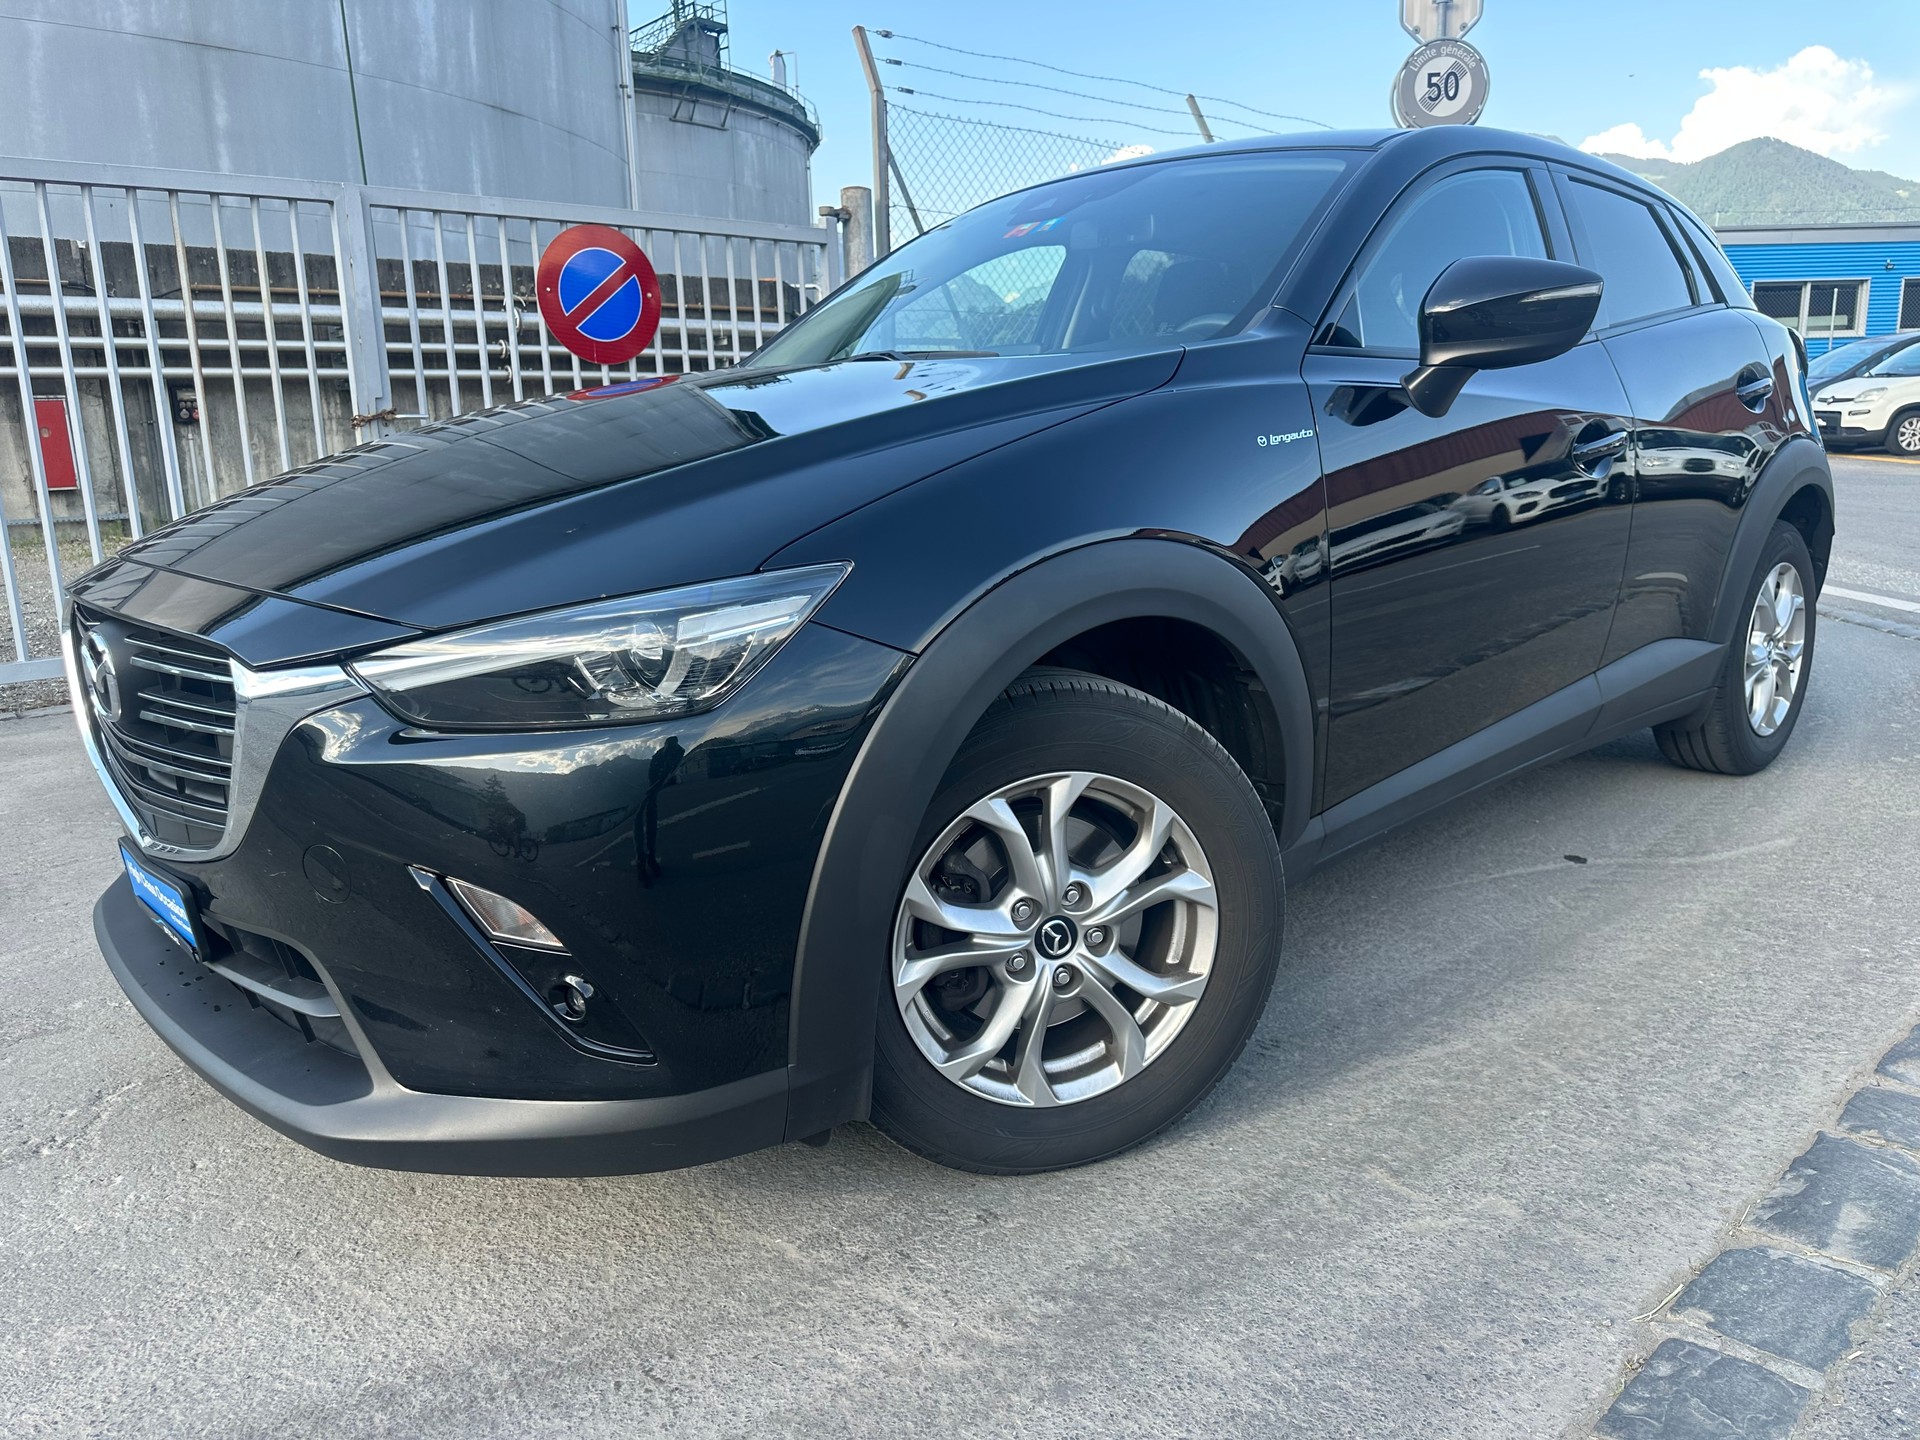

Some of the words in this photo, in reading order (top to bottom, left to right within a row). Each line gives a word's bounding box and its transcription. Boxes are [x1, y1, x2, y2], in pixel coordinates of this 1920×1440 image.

[1410, 48, 1437, 72] Limite
[1440, 44, 1477, 69] générale
[1427, 71, 1460, 102] 50
[1269, 428, 1314, 446] Longauto
